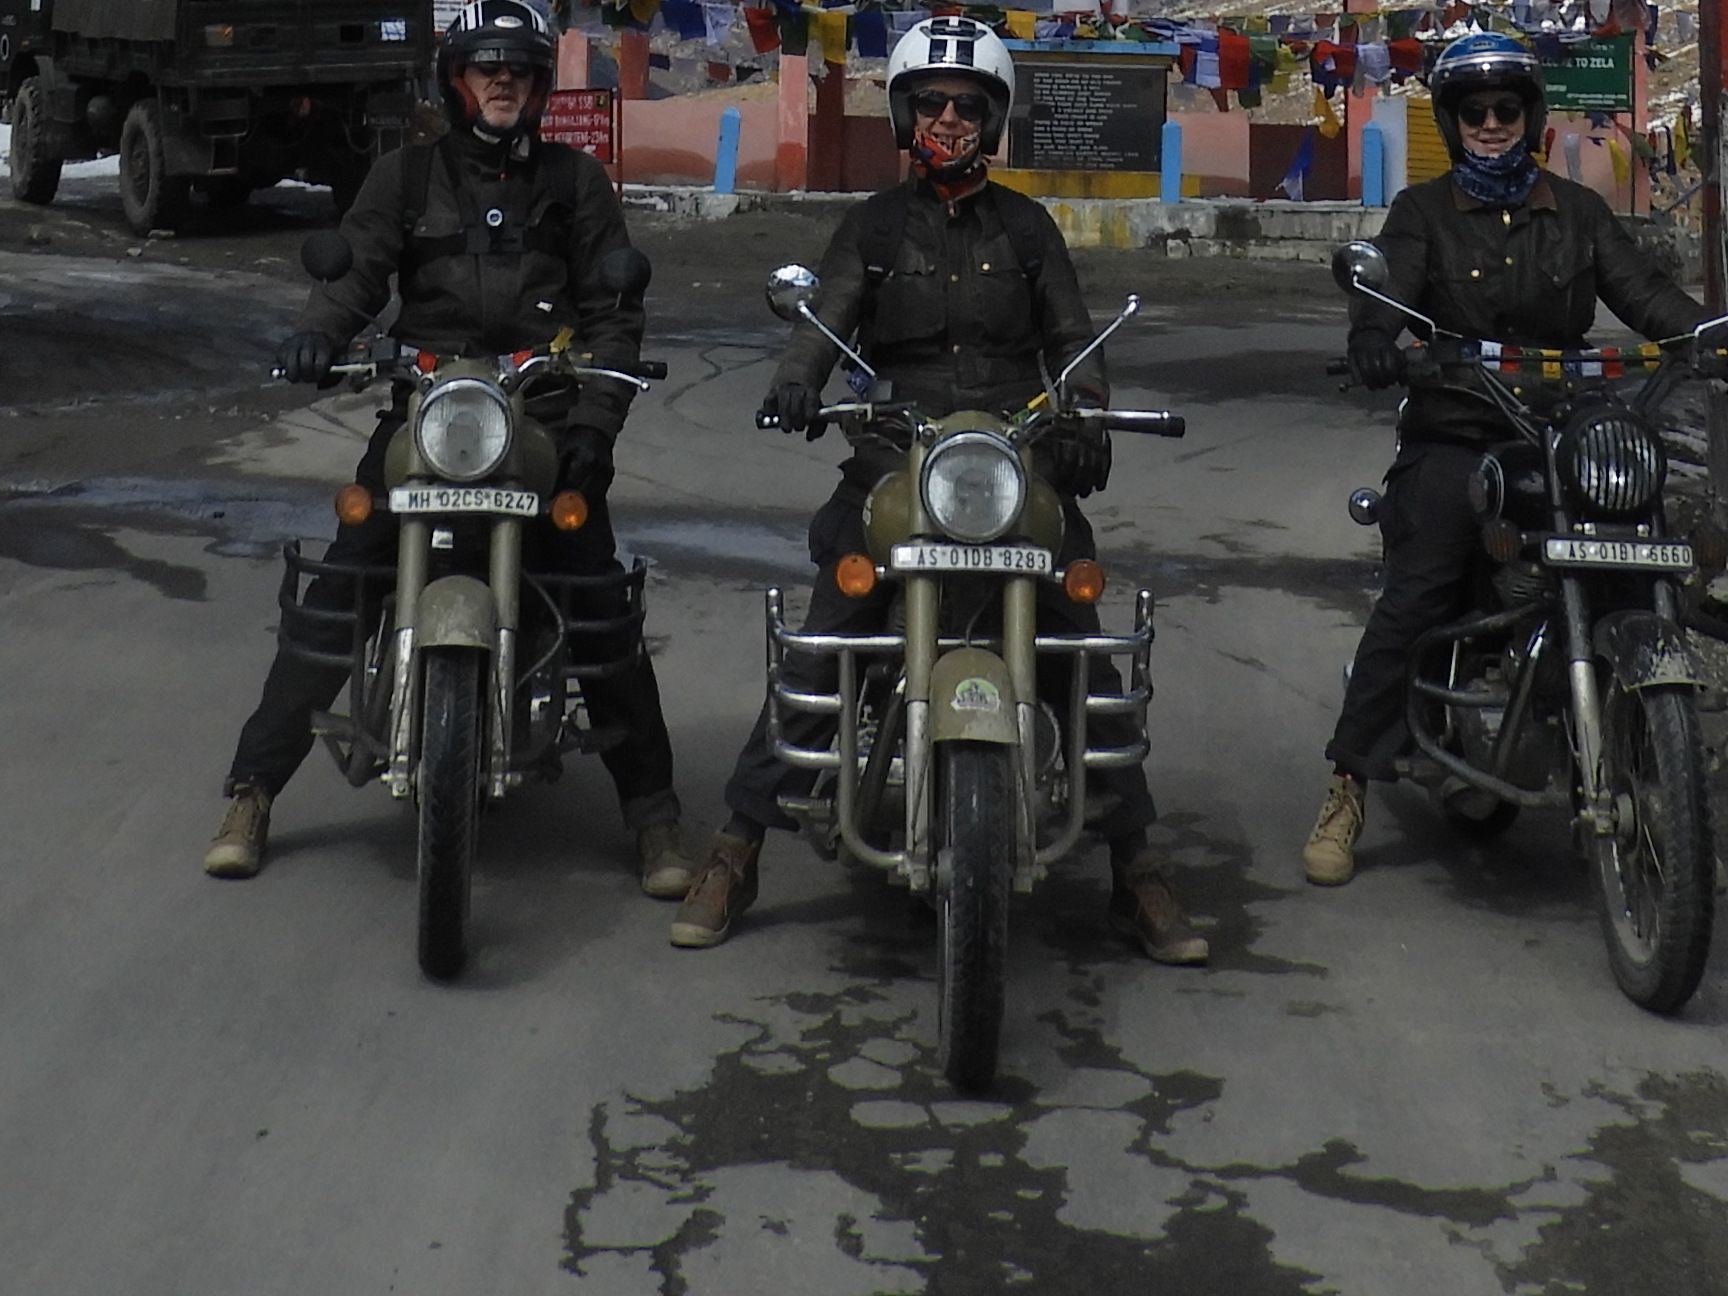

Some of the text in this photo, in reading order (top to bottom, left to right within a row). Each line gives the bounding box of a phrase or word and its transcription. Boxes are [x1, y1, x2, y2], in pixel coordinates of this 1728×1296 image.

[408, 492, 431, 509] MH
[494, 492, 535, 511] 6247
[917, 548, 938, 566] AS
[1003, 549, 1046, 569] 8283
[1569, 542, 1587, 559] AS
[1650, 545, 1690, 564] 6660
